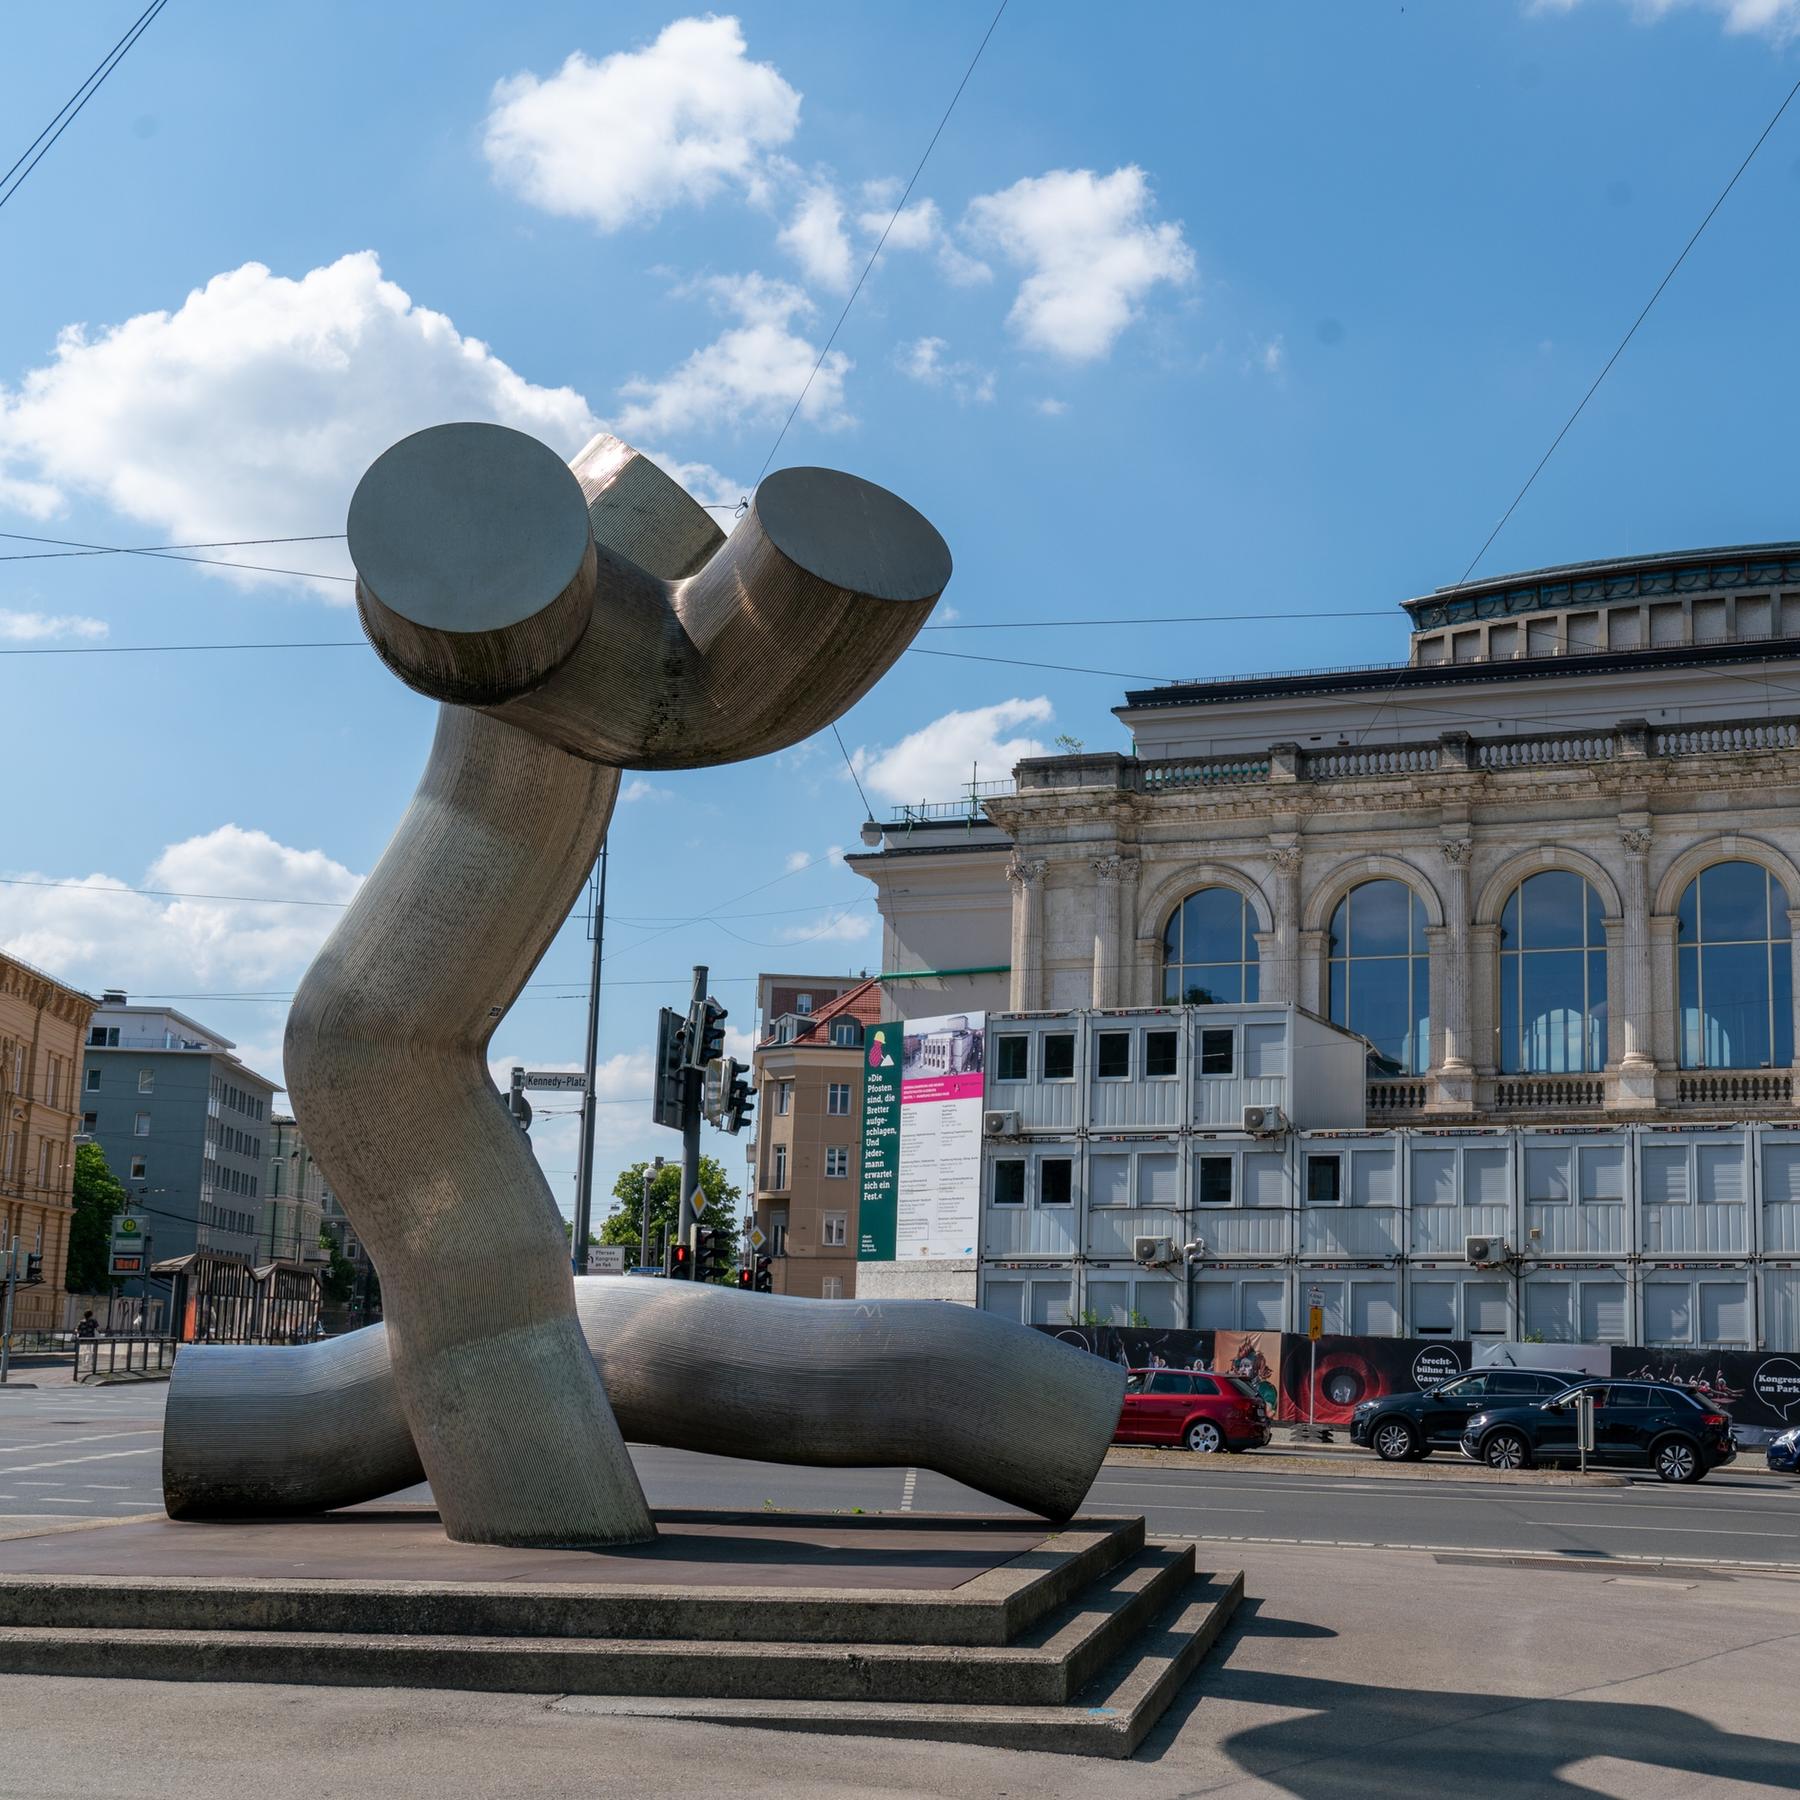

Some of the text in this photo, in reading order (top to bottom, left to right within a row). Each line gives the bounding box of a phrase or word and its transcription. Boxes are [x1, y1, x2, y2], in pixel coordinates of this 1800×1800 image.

[528, 1076, 586, 1088] Kennedy-Platz
[868, 1085, 892, 1093] Pfosten
[867, 1095, 883, 1104] sind,
[866, 1106, 889, 1114] Bretter
[866, 1116, 888, 1126] aufge-
[866, 1128, 896, 1136] schlagen,
[866, 1138, 880, 1146] Und
[865, 1149, 884, 1159] jeder-
[864, 1170, 892, 1178] erwartet
[864, 1181, 878, 1190] sich
[879, 1180, 890, 1188] ein
[1422, 1357, 1452, 1365] brecht-
[1416, 1366, 1444, 1374] bühne
[1758, 1374, 1800, 1384] Kongress
